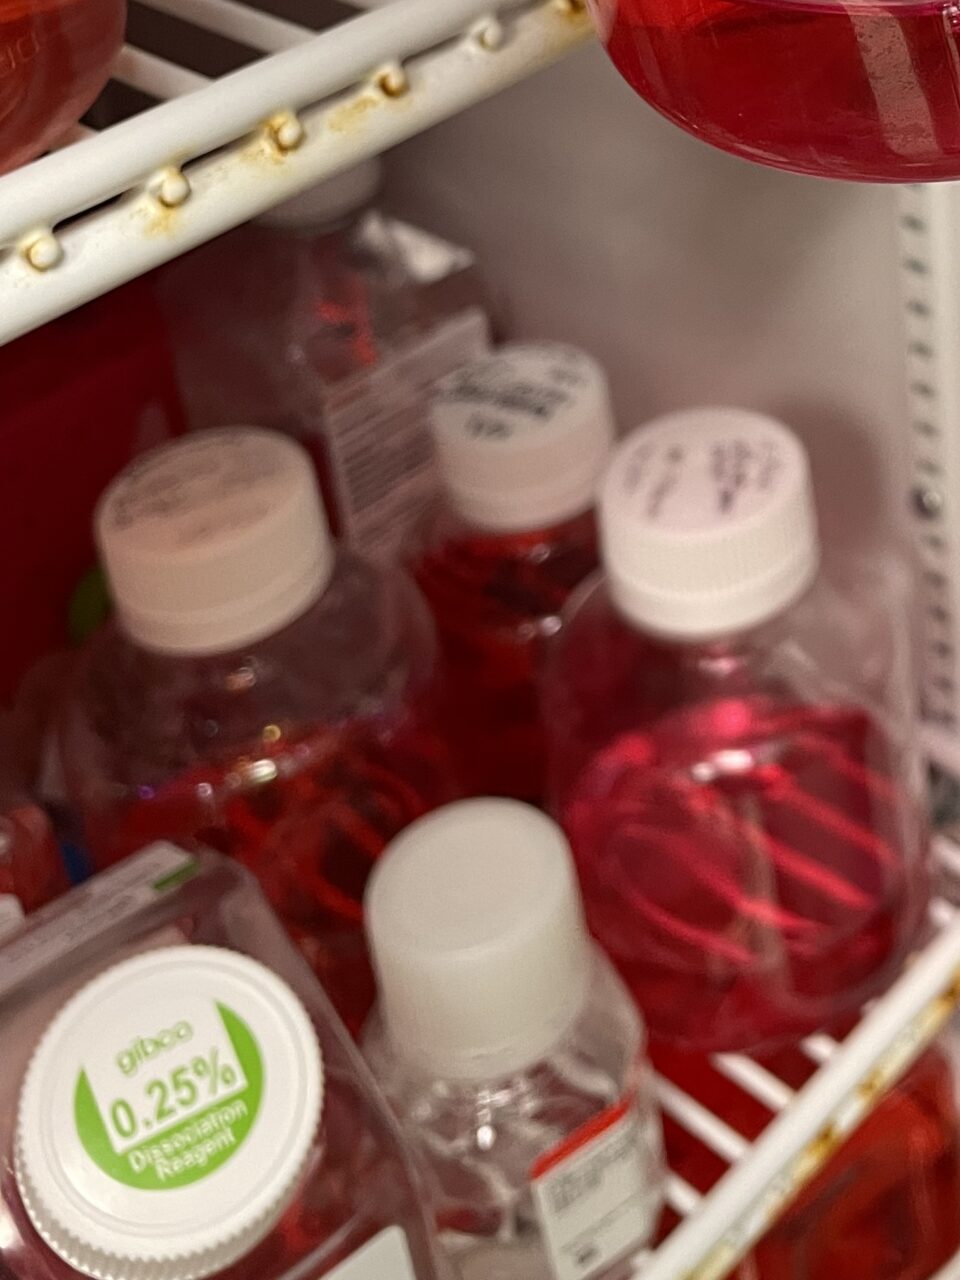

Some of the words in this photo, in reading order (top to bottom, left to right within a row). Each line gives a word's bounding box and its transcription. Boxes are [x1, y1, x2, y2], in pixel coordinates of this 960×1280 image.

[116, 1020, 194, 1076] gibco
[110, 1047, 237, 1139] 0.25%
[128, 1099, 249, 1174] Dissociation
[153, 1127, 237, 1183] Reagent
